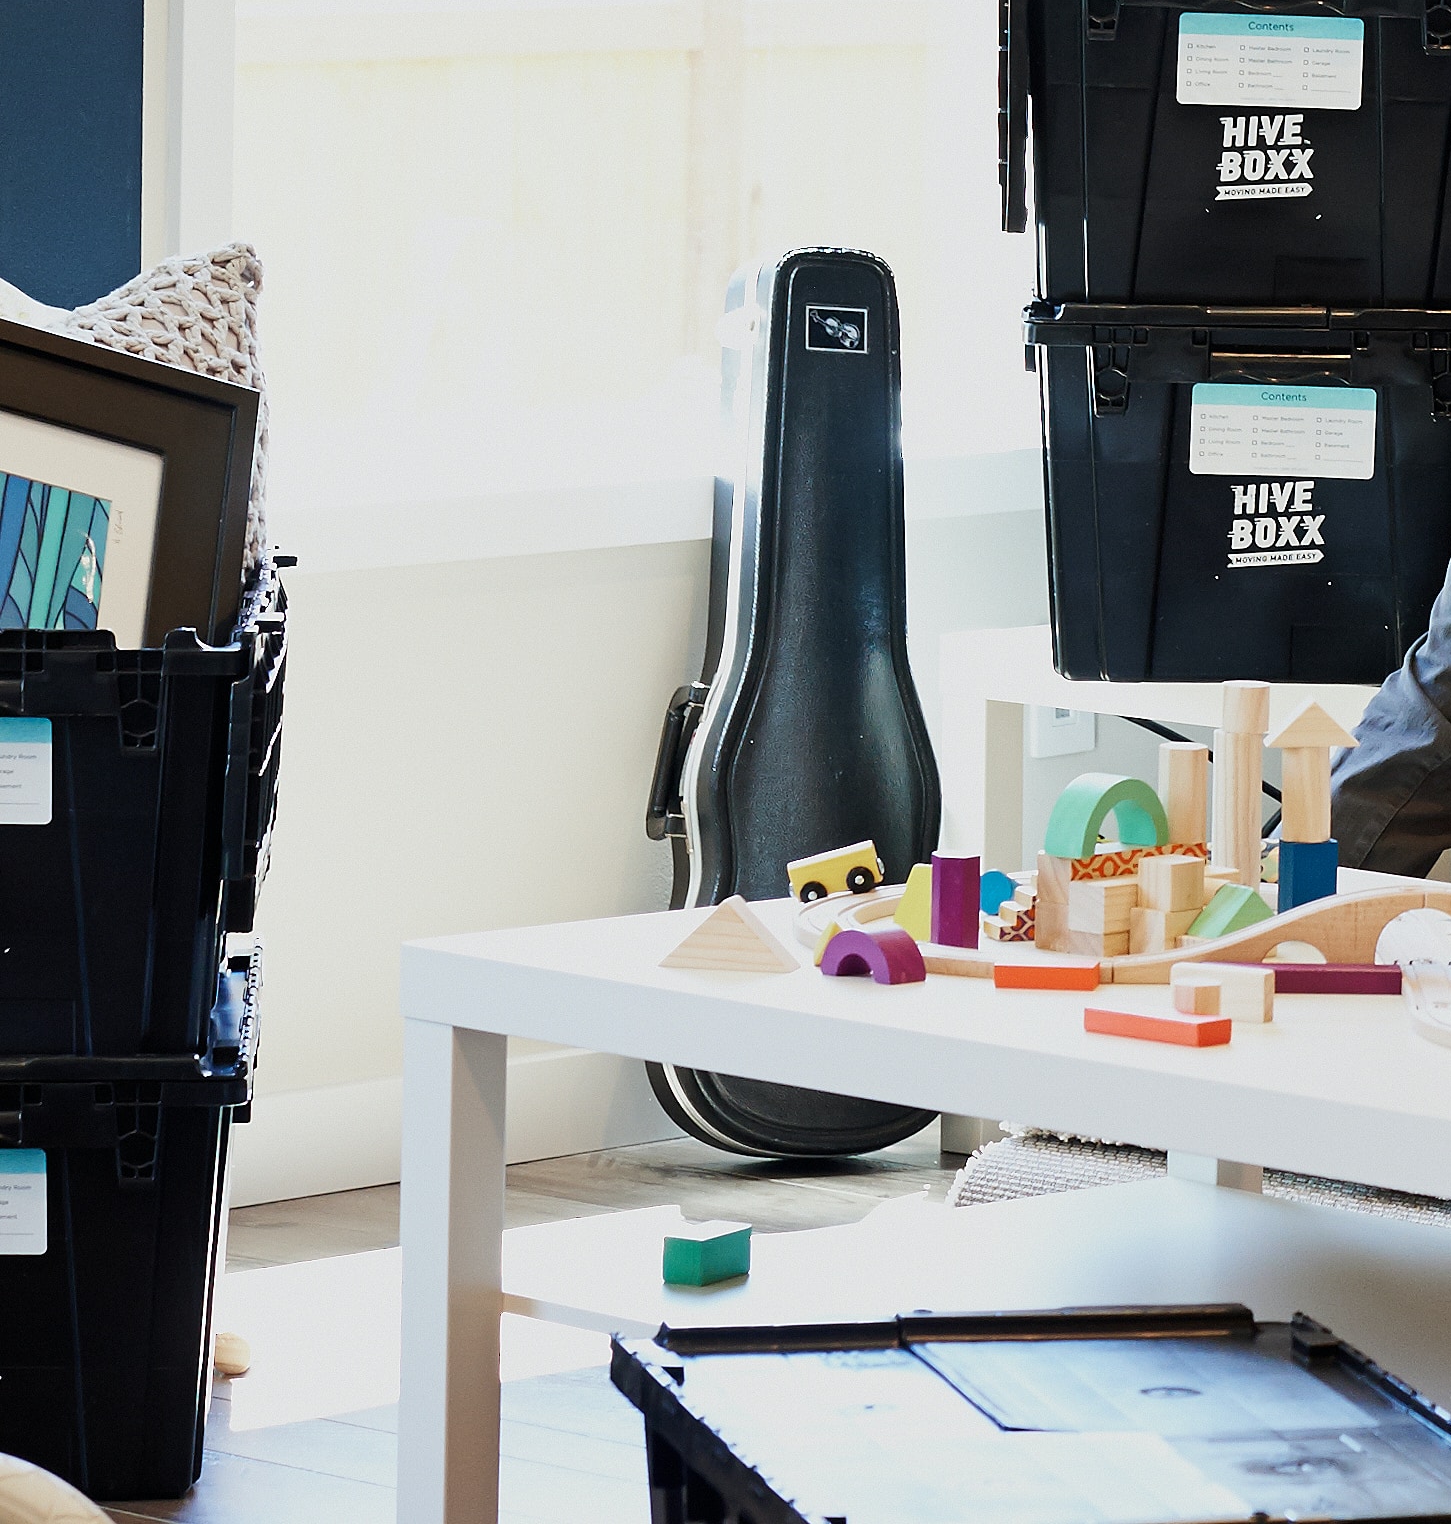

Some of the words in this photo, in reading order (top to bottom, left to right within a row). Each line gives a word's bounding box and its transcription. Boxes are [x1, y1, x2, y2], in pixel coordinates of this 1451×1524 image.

[1248, 21, 1294, 32] Contents
[1219, 114, 1303, 148] HIVE
[1216, 149, 1314, 182] BOXX
[1261, 392, 1307, 402] Contents
[1230, 481, 1314, 515] HIVE
[1227, 515, 1325, 549] BOXX
